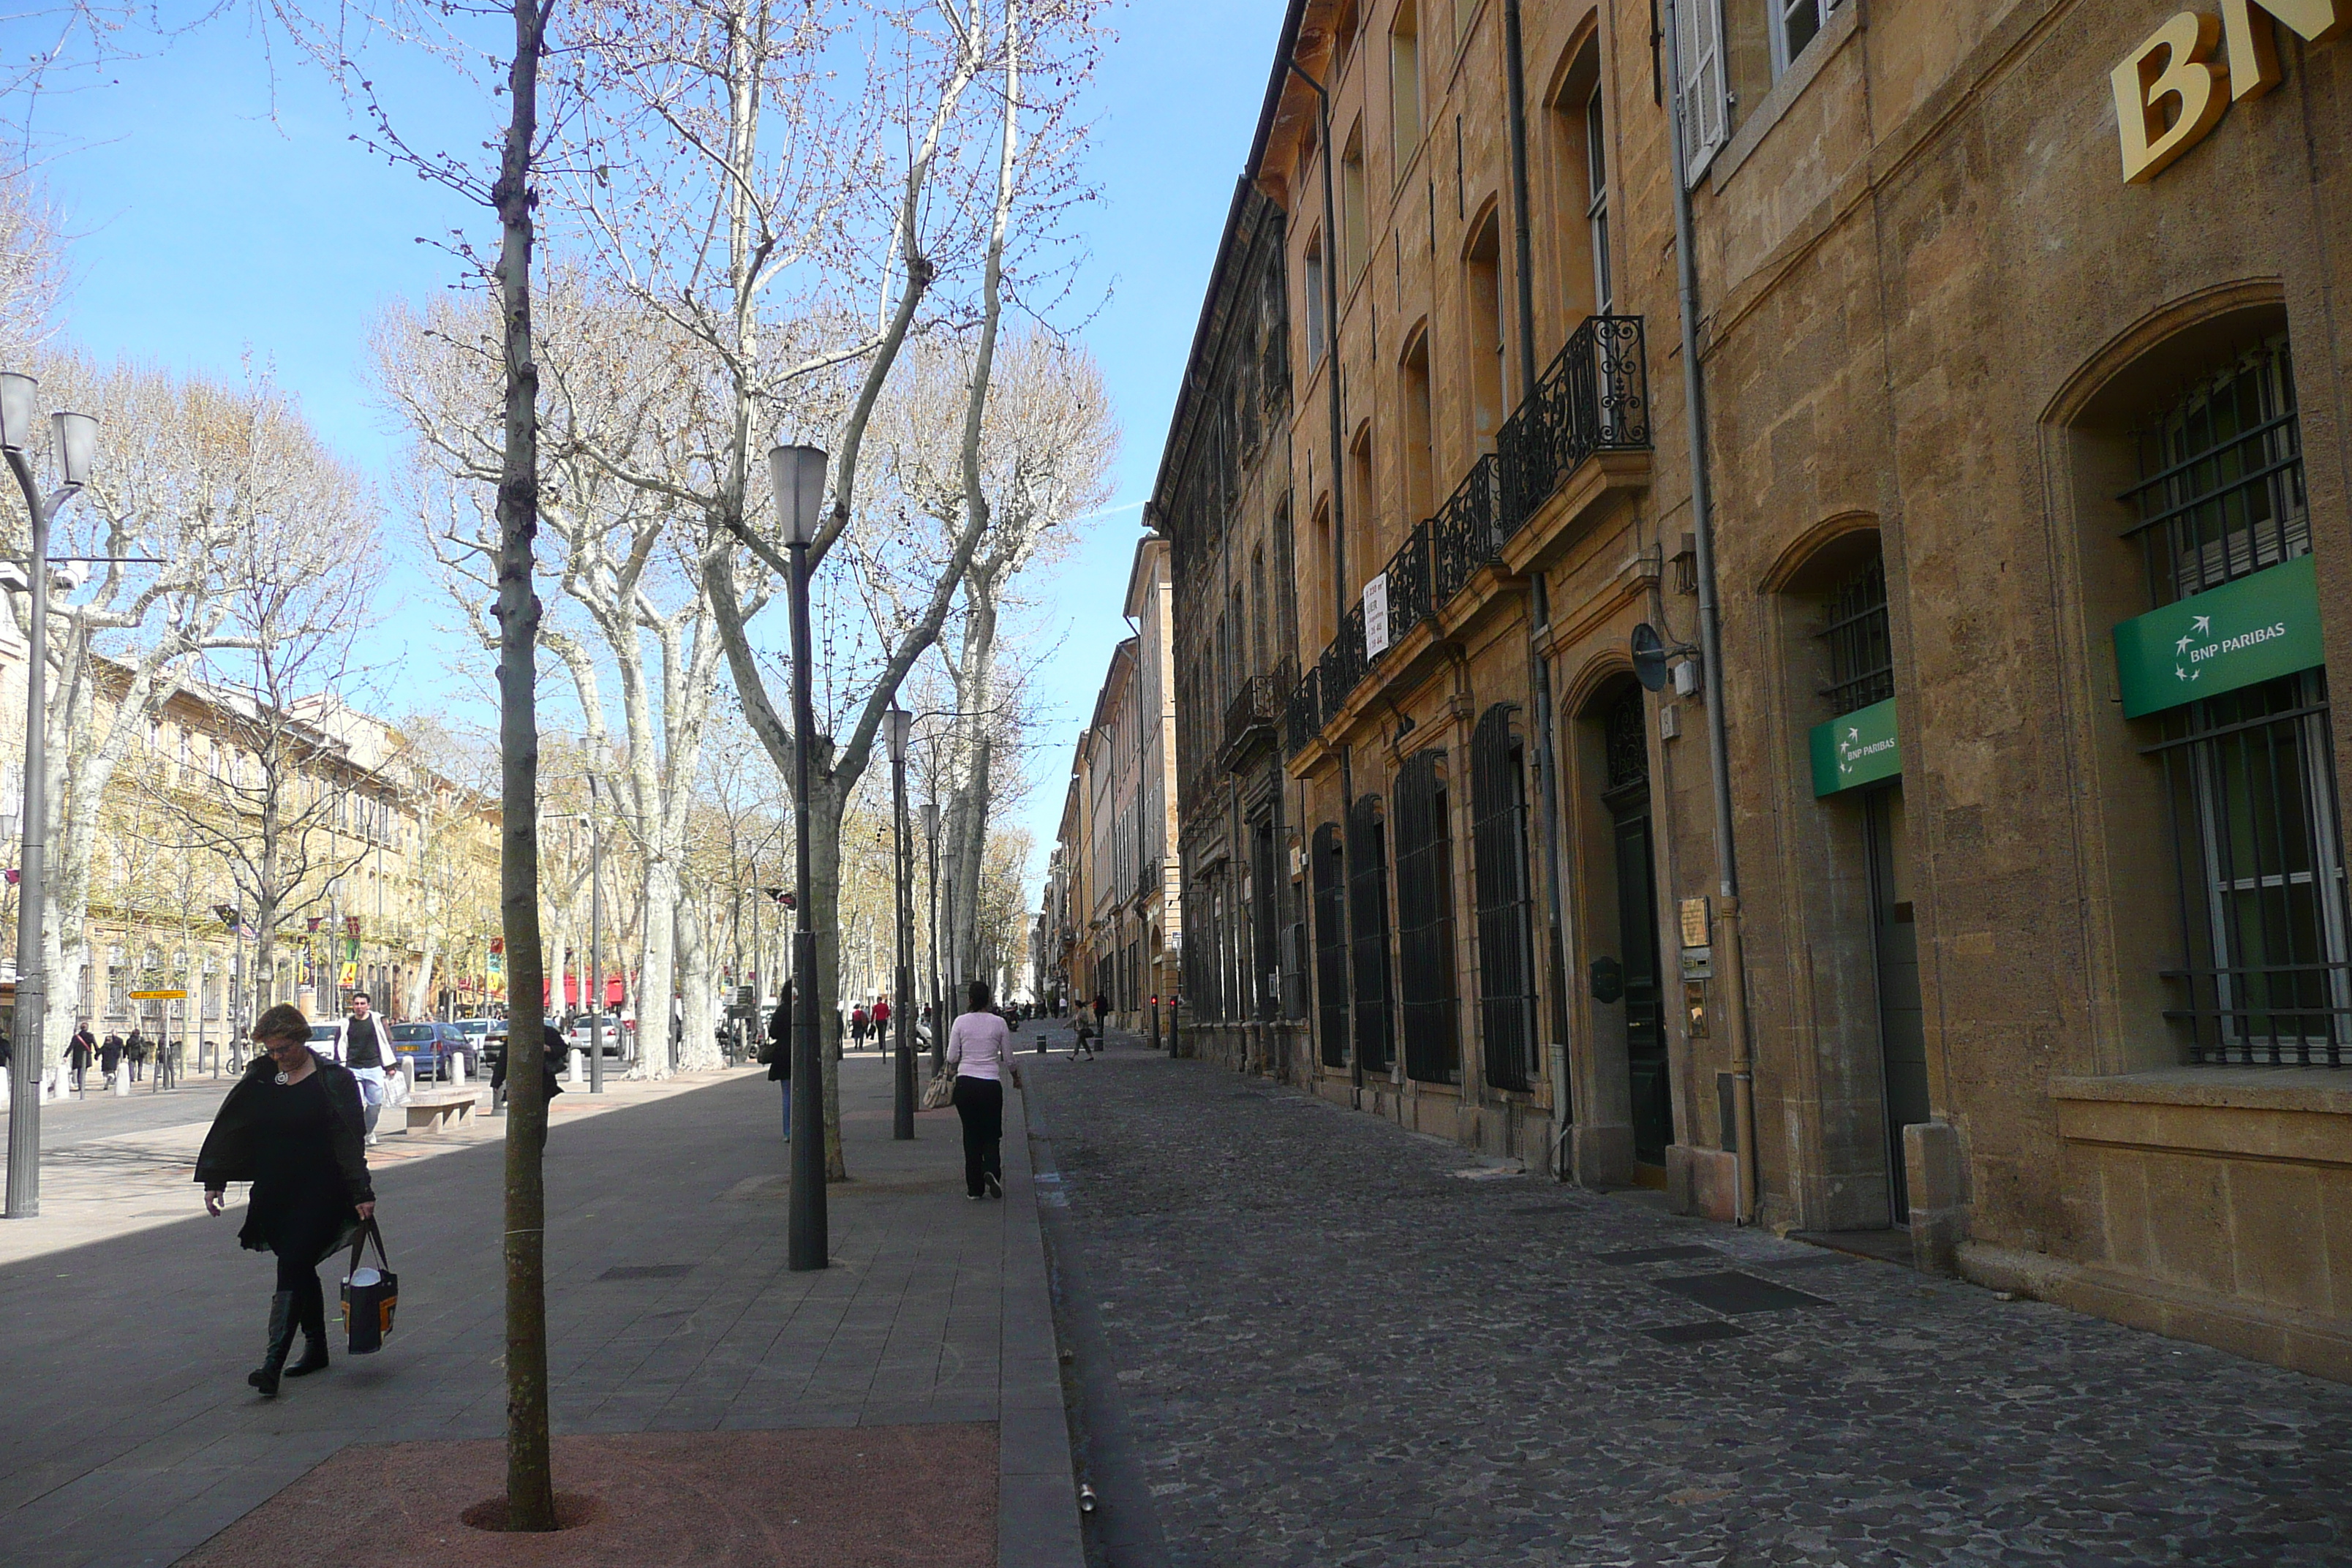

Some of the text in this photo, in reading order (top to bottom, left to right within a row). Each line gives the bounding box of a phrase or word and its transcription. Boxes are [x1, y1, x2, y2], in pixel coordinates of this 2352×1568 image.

[2190, 622, 2285, 663] BNP PARIBAS
[1847, 738, 1895, 761] BNP PARIBAS
